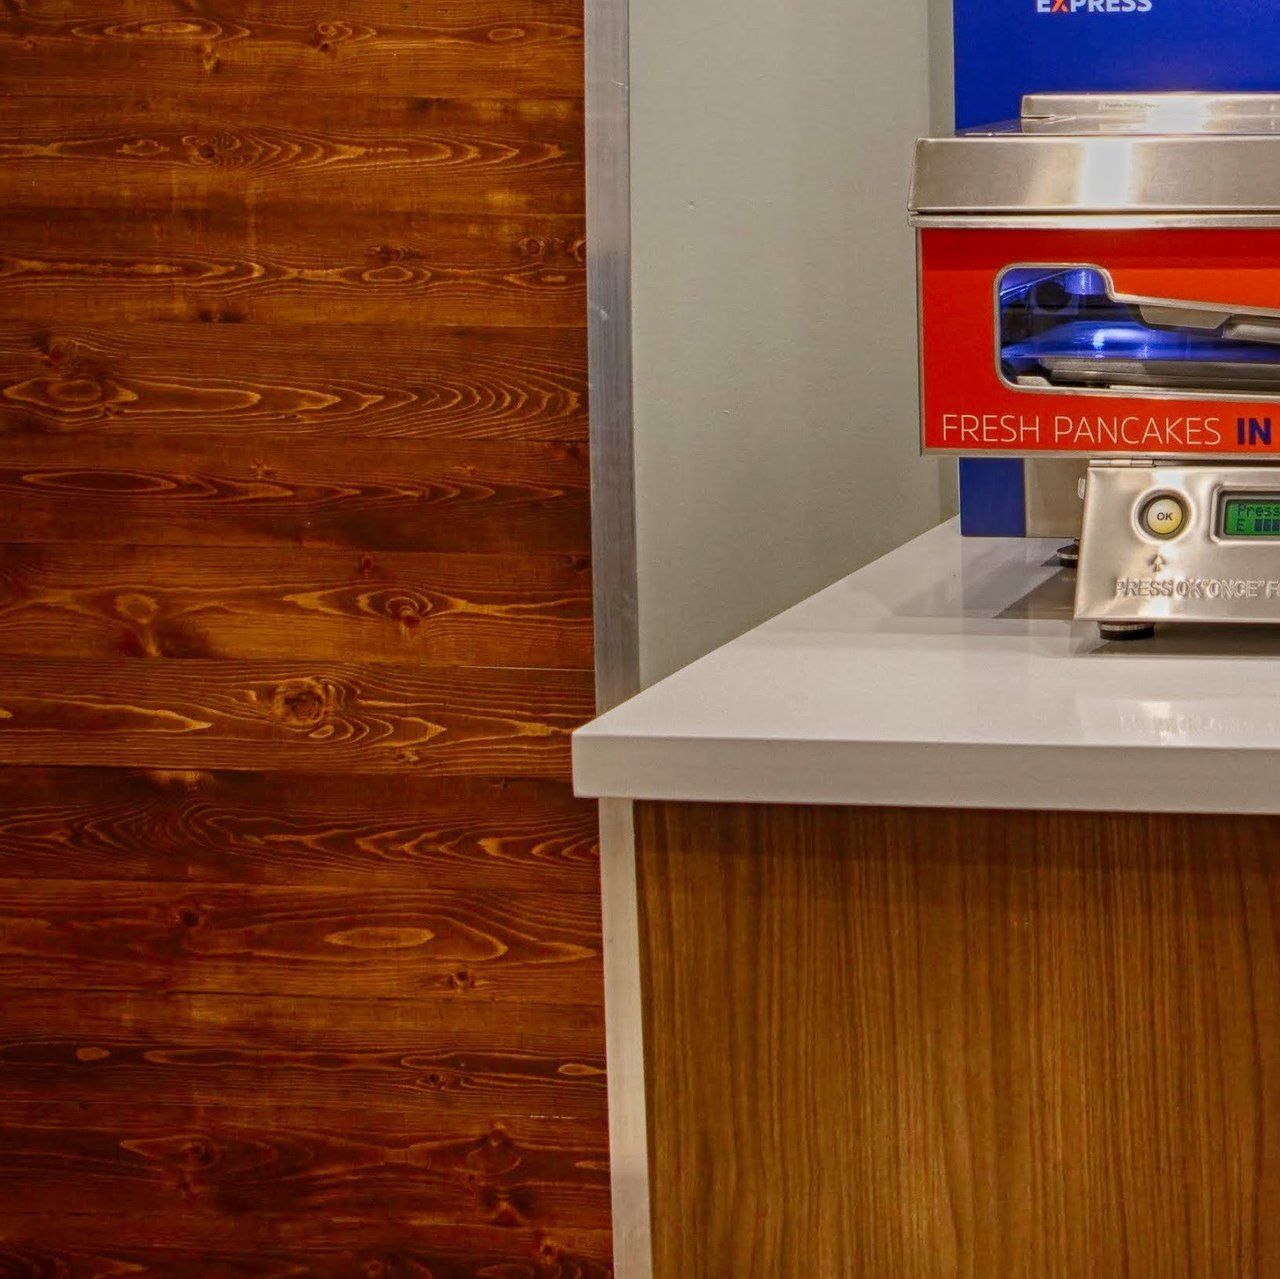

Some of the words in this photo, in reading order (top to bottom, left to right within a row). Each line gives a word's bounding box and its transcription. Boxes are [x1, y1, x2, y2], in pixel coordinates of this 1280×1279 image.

[942, 414, 1040, 443] FRESH
[1054, 416, 1221, 445] PANCAKES
[1237, 417, 1272, 445] IN
[1156, 511, 1174, 522] OK
[1237, 504, 1280, 517] Press
[1116, 578, 1173, 597] PRESS
[1176, 580, 1203, 598] OK
